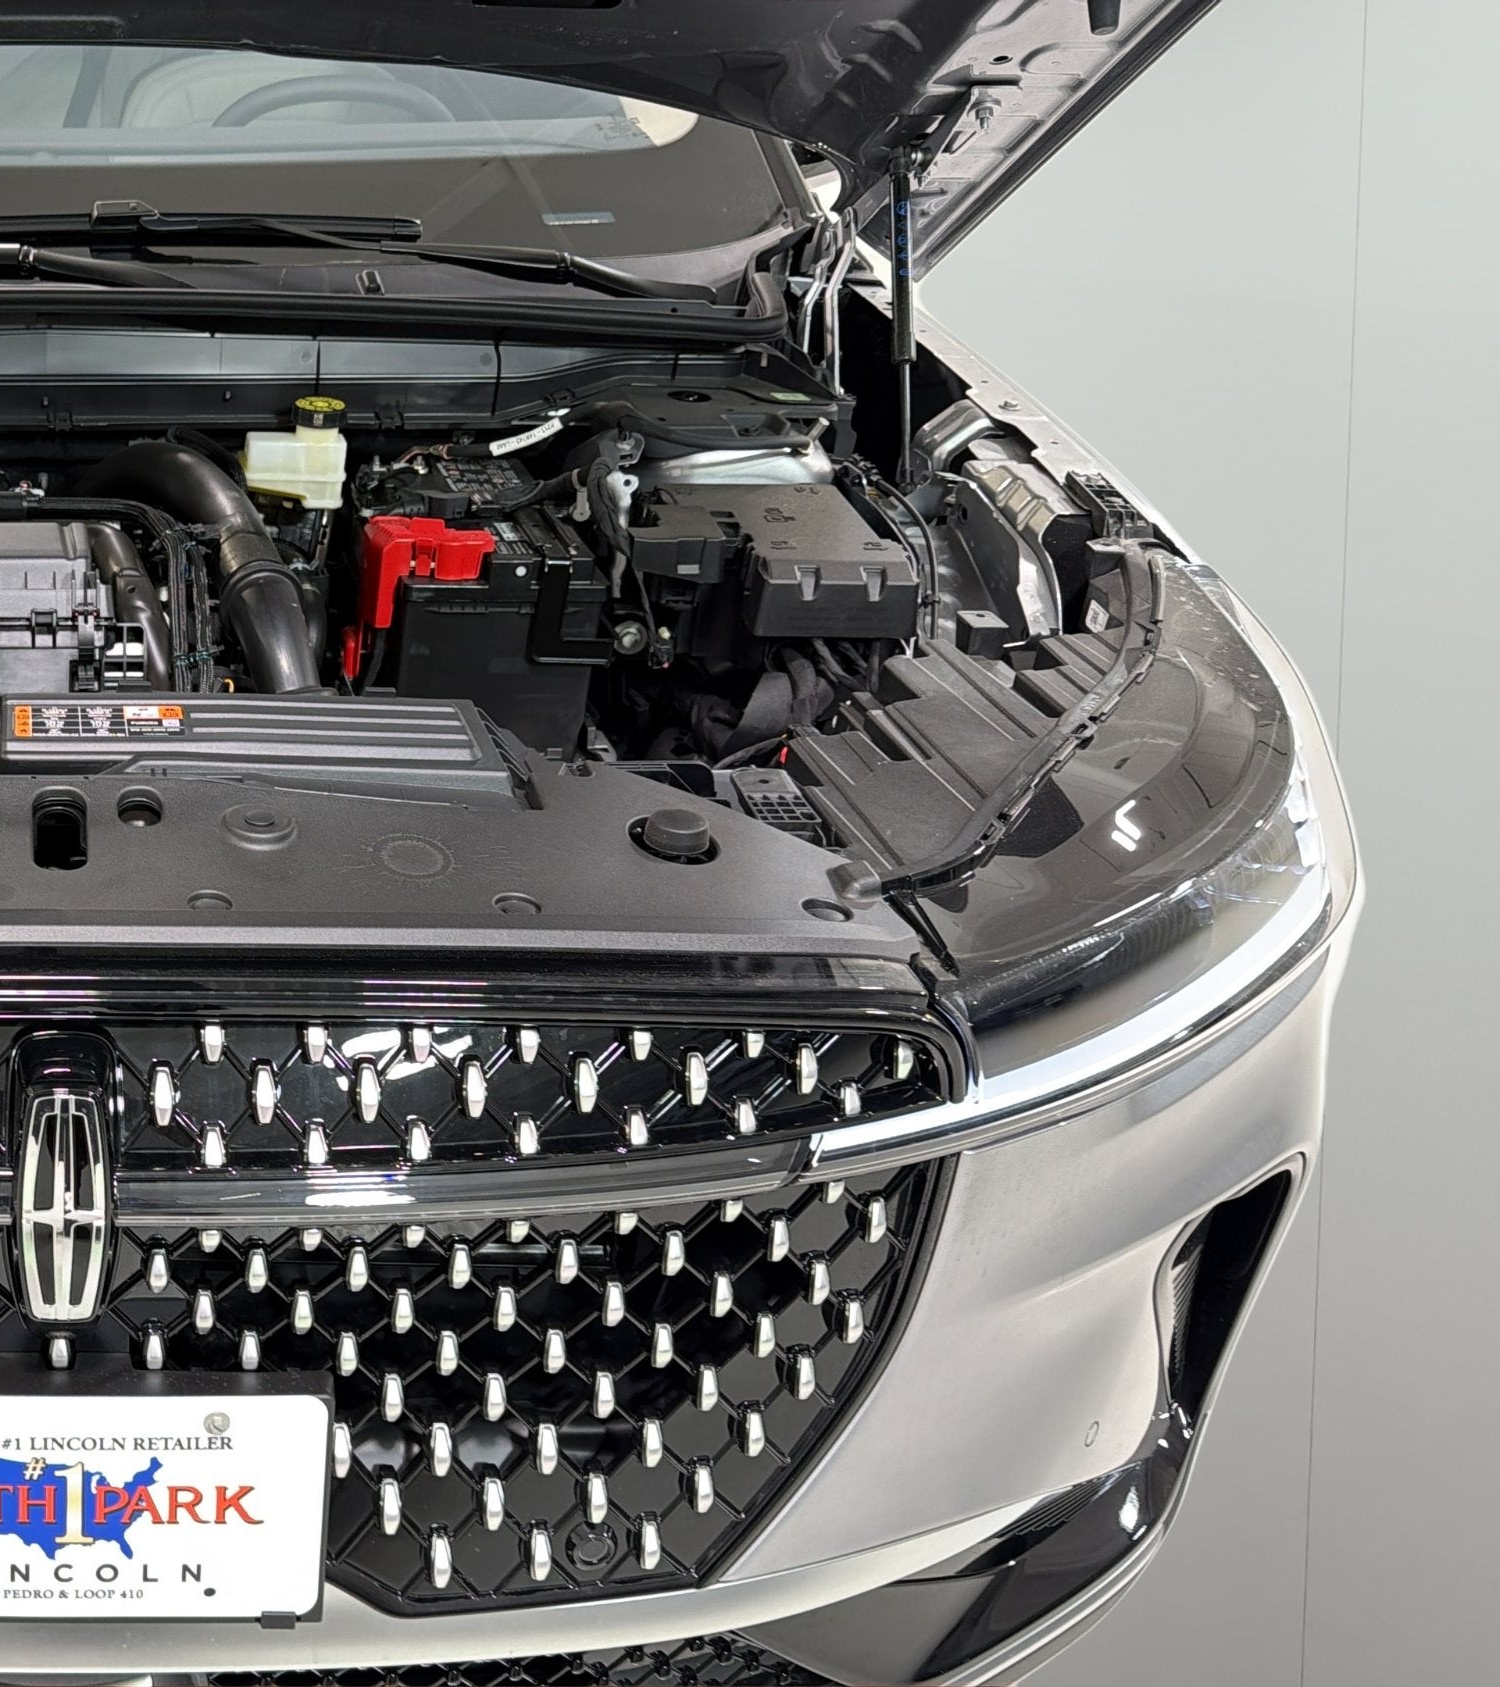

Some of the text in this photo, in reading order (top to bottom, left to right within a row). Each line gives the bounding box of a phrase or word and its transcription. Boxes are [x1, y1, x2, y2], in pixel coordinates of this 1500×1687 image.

[2, 1438, 22, 1450] #1
[30, 1436, 126, 1450] LINCOLN
[133, 1436, 234, 1450] RETAILER
[93, 1484, 265, 1525] PARK
[3, 1589, 54, 1599] PEDRO
[58, 1589, 69, 1599] &
[74, 1589, 116, 1599] LOOP
[120, 1589, 144, 1599] 410
